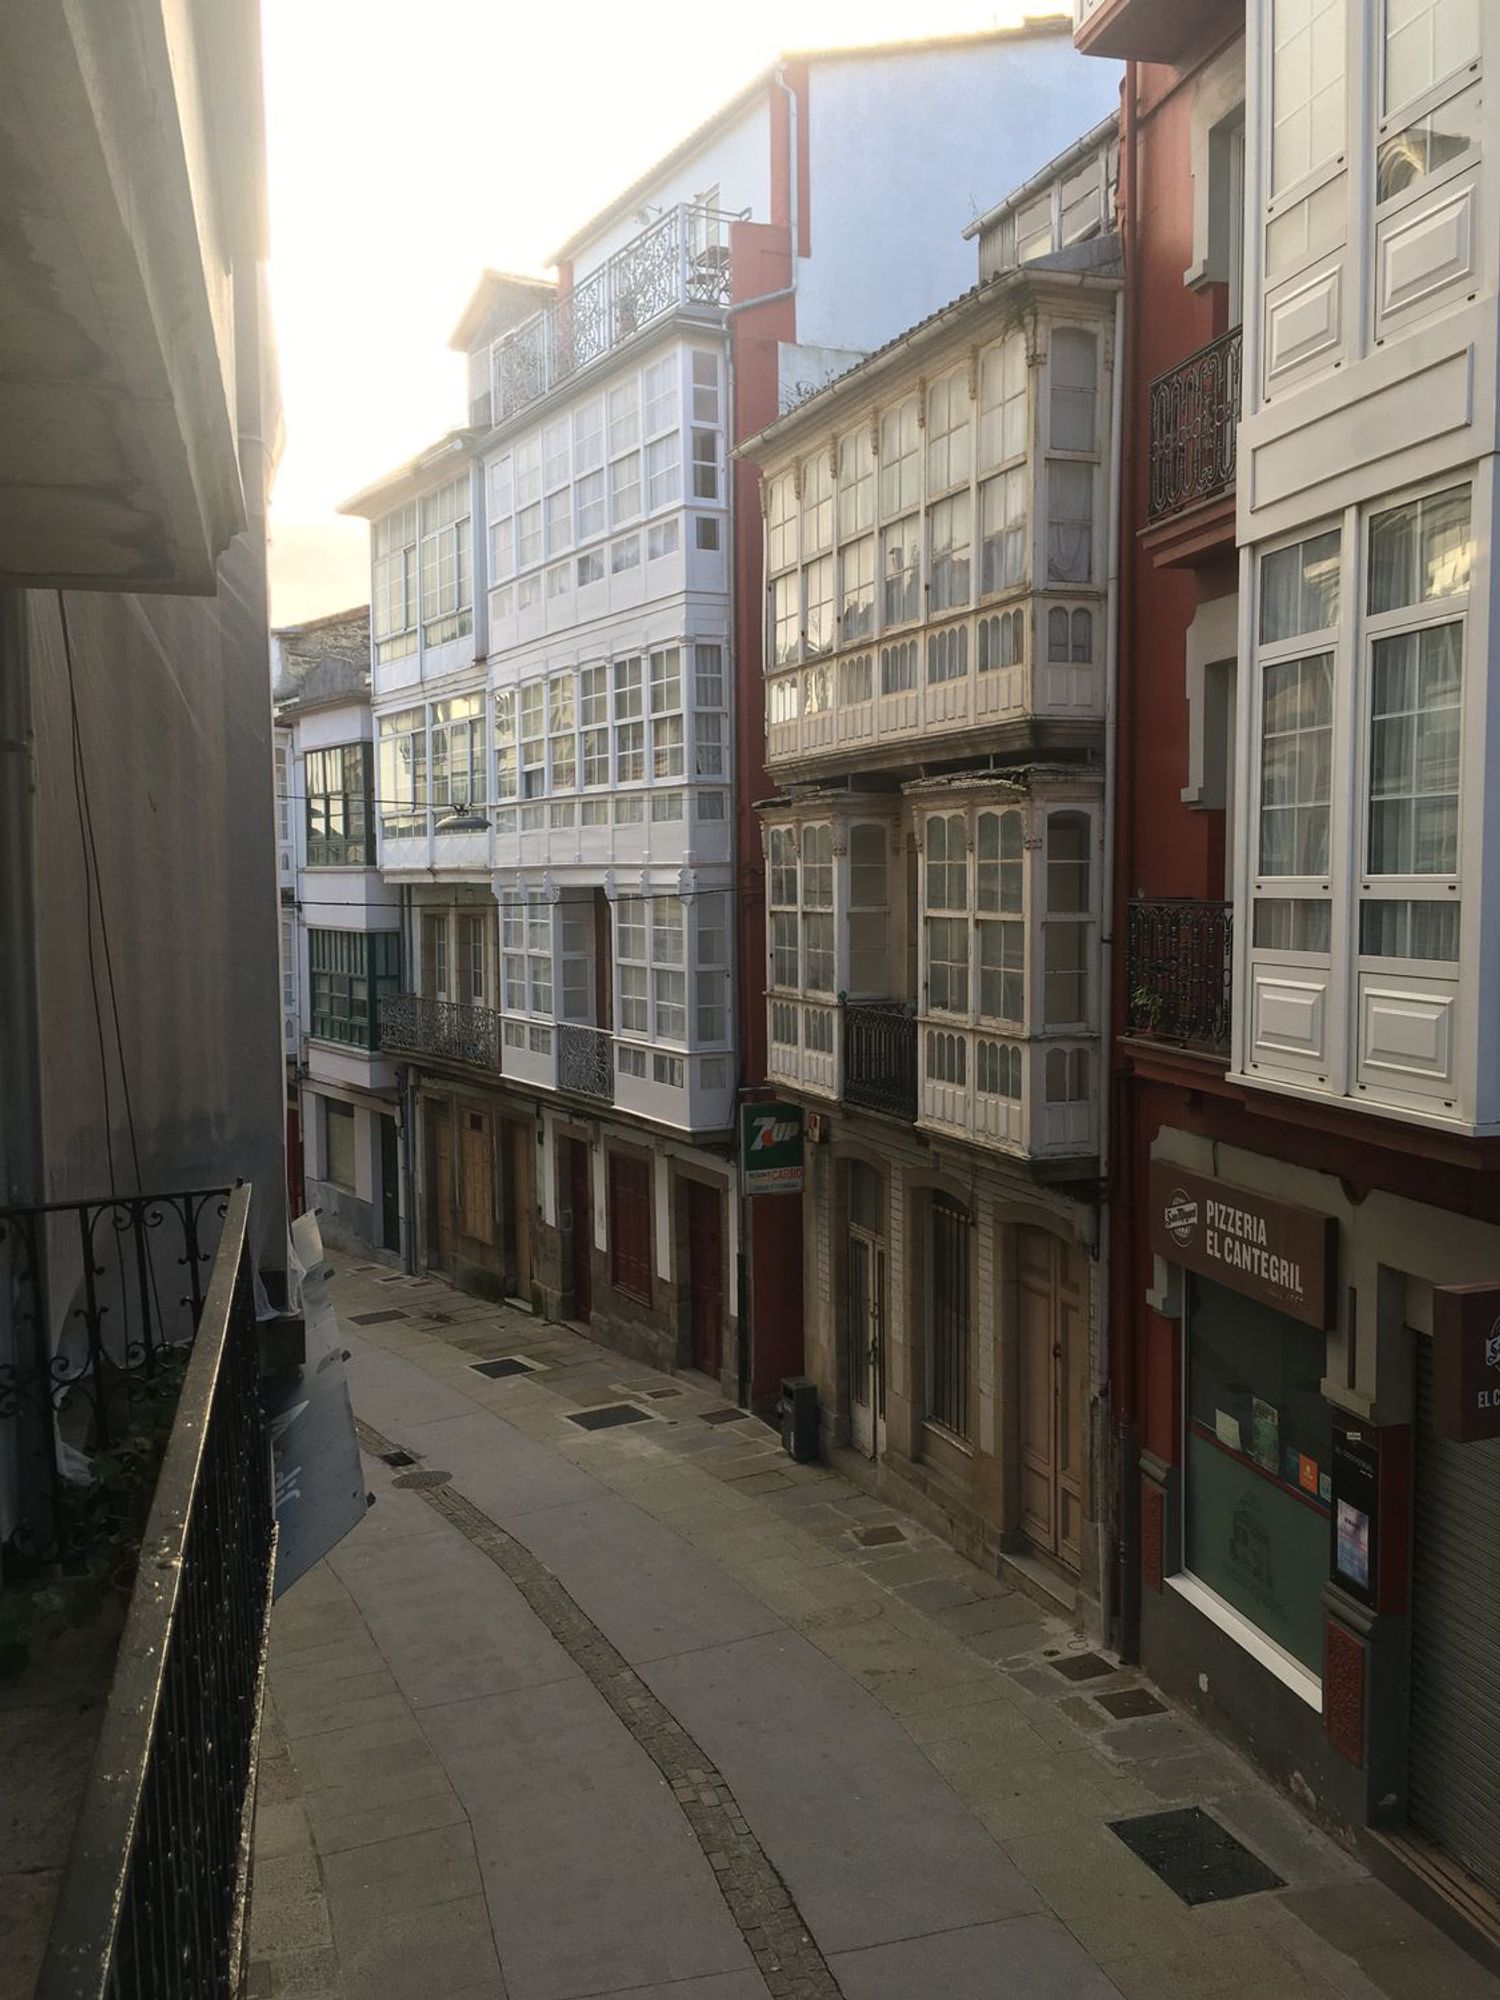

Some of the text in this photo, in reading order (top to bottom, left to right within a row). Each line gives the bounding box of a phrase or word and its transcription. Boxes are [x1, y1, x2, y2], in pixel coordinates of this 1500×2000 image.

[1206, 1199, 1267, 1246] PIZZERIA
[1206, 1229, 1303, 1293] EL CANTEGRIL
[1478, 1391, 1490, 1408] EL
